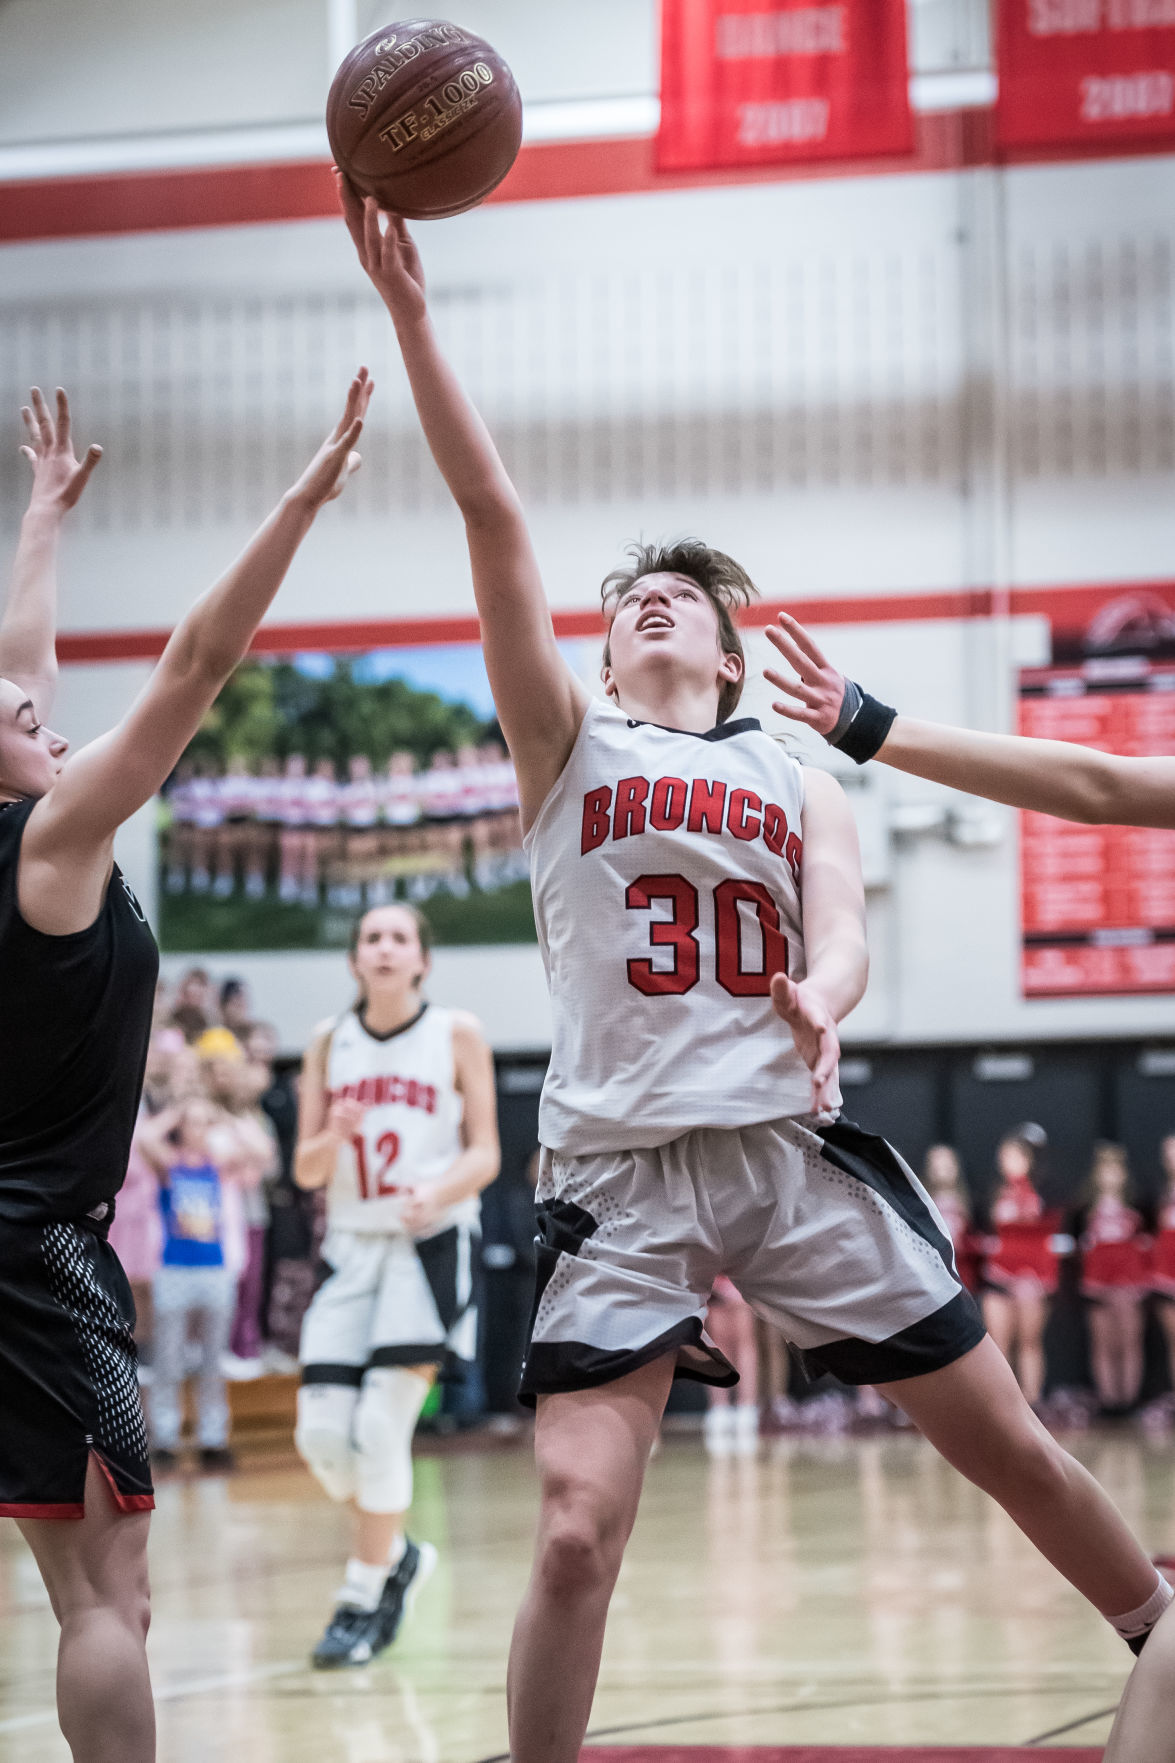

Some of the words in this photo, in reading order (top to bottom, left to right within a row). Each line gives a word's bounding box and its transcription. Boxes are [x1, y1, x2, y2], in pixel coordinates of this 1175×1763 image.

[348, 25, 470, 121] SPALDING
[379, 62, 493, 152] TF-1000
[625, 873, 789, 998] 30
[351, 1130, 415, 1201] 12
